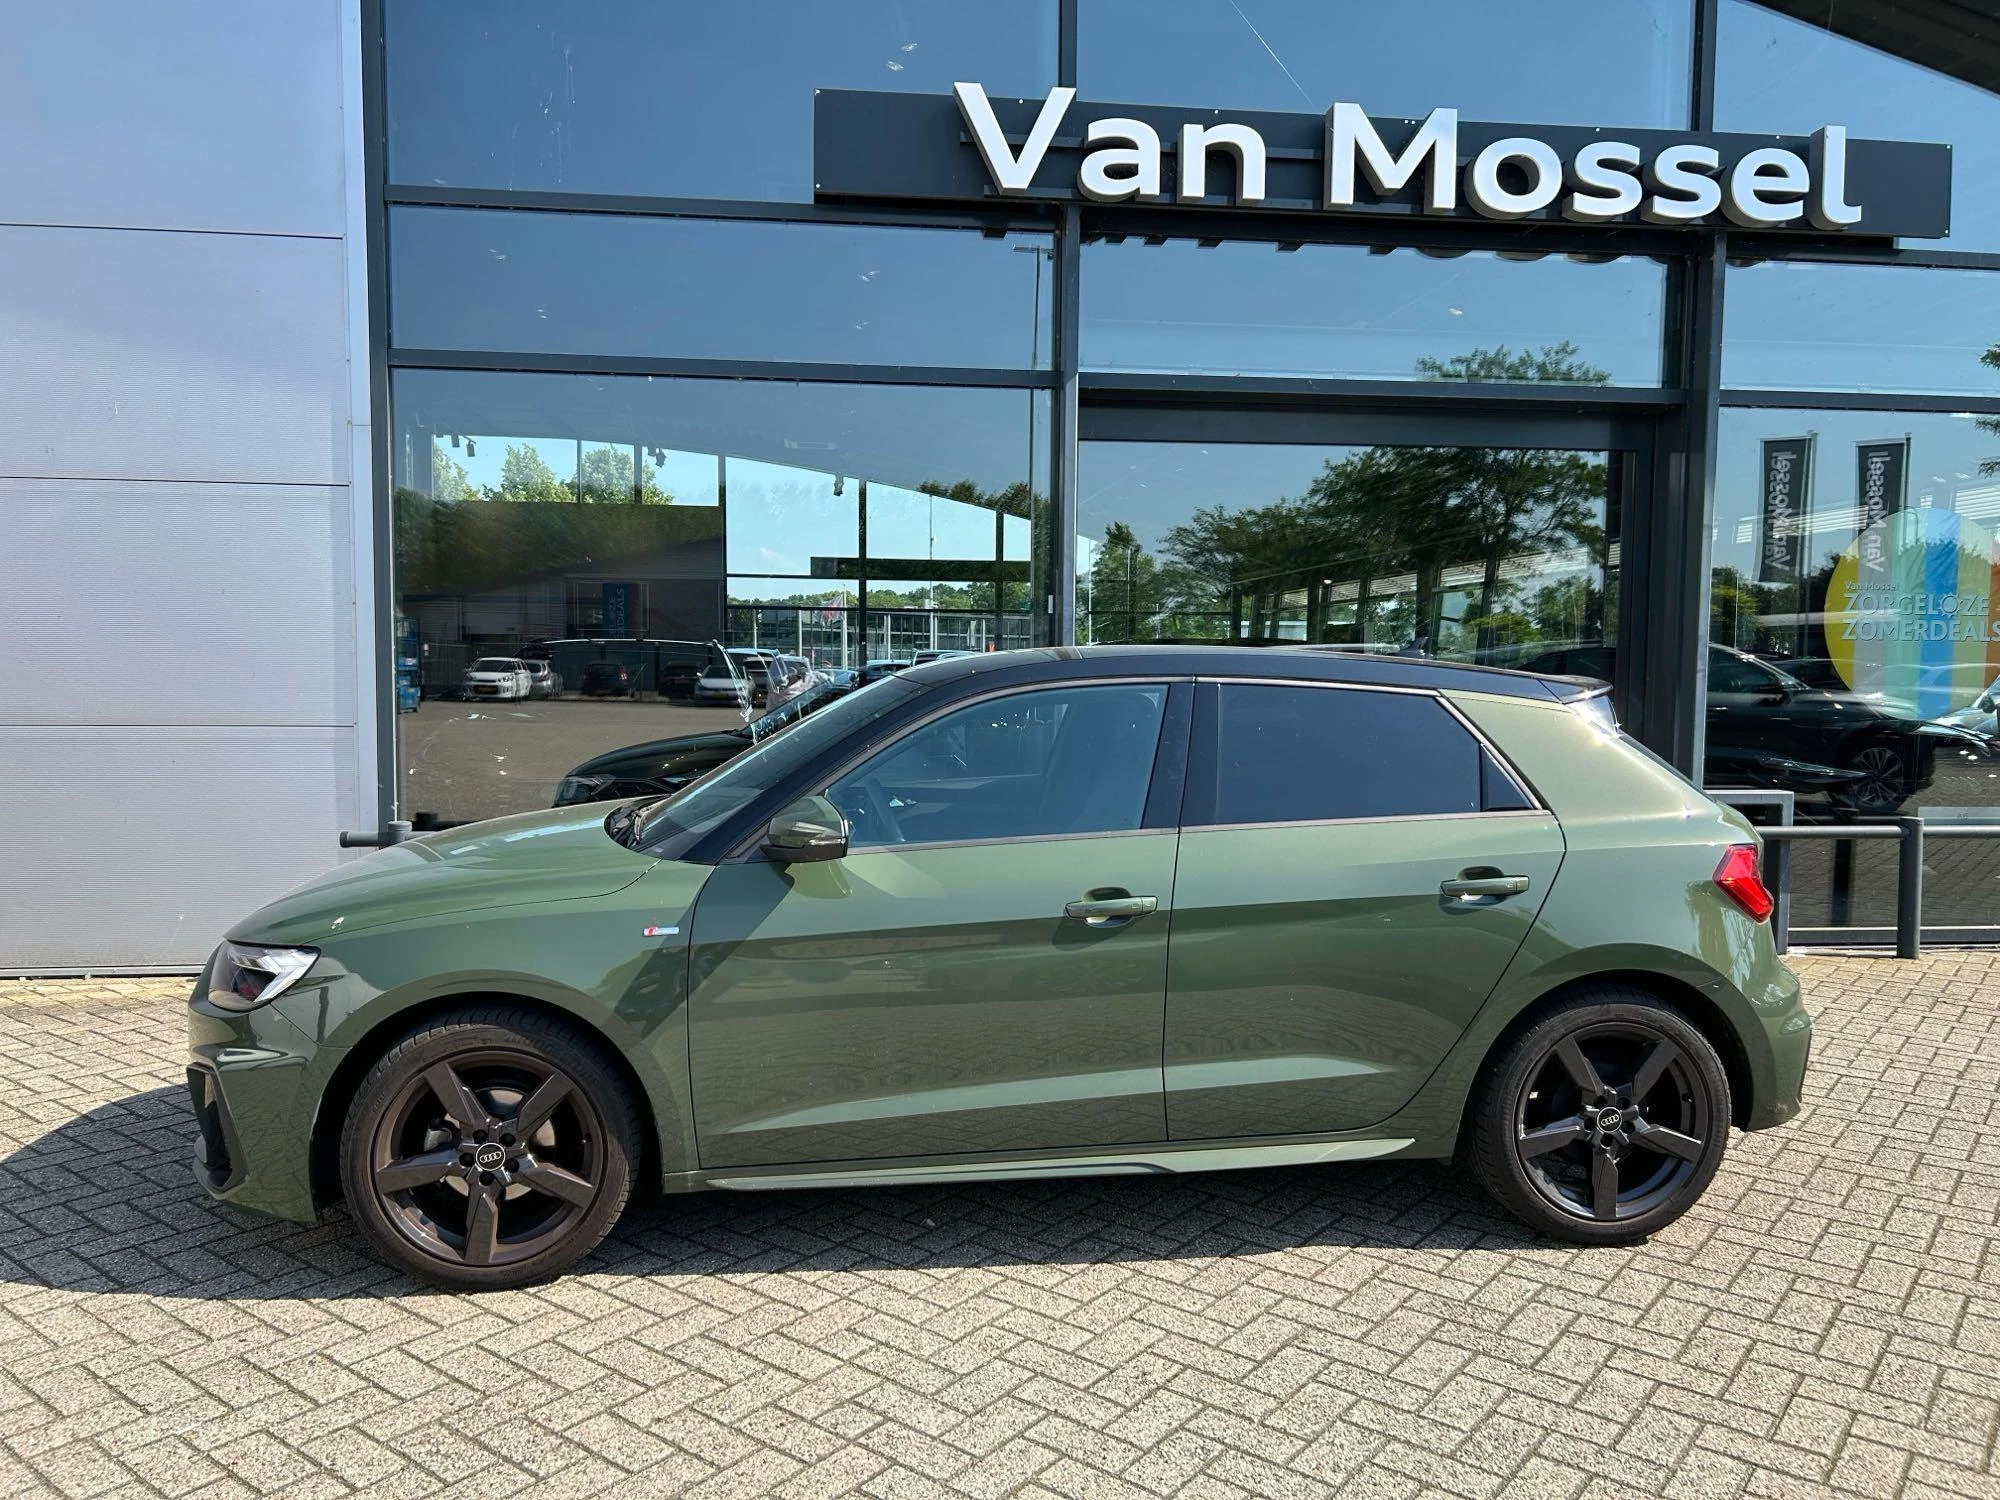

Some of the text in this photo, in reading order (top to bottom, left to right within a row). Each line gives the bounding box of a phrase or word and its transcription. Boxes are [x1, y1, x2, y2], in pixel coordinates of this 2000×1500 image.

[953, 81, 1862, 231] Van Mossel
[1844, 581, 1862, 591] Van
[1842, 592, 1990, 618] ZORGELOZE
[1841, 618, 2000, 642] ZOMERDEALS
